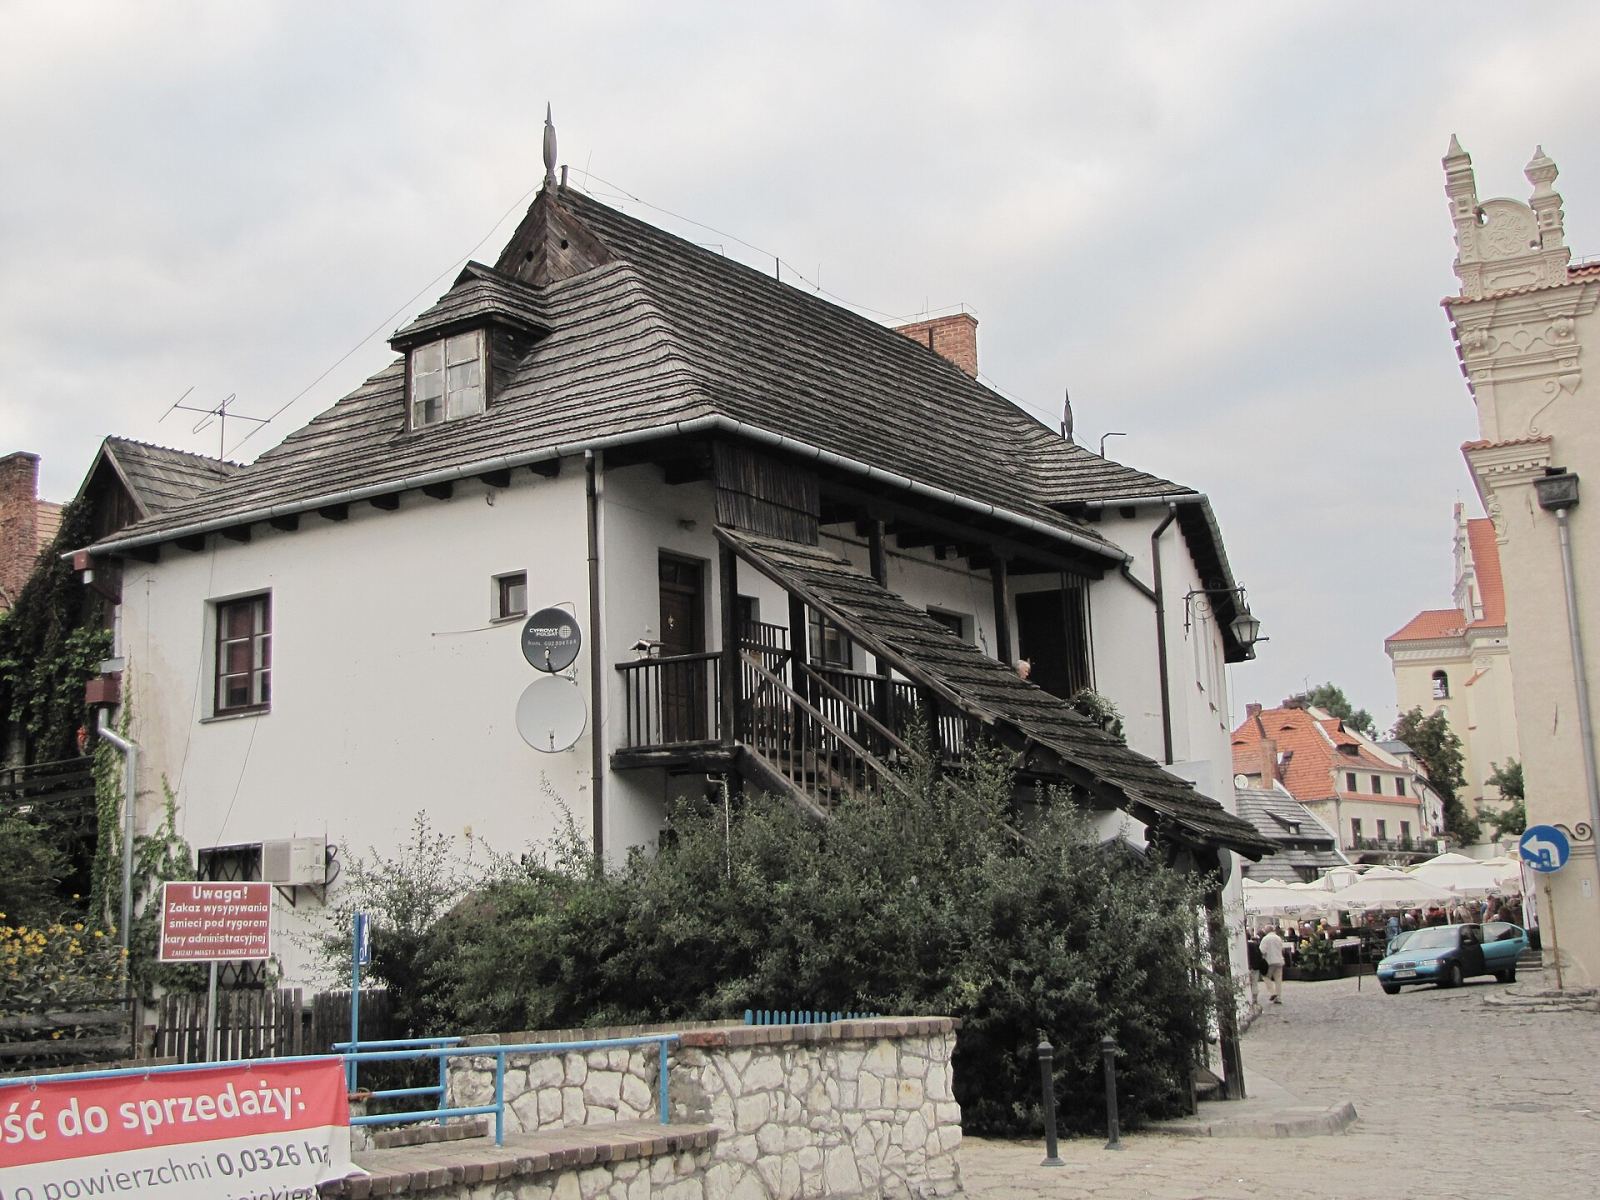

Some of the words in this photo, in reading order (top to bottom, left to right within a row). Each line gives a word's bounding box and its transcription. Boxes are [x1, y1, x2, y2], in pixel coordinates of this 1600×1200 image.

[192, 886, 248, 902] Uwaga!
[169, 903, 201, 913] Zakaz
[203, 902, 268, 915] wysypywania
[169, 918, 202, 928] śmieci
[204, 918, 224, 930] pod
[226, 919, 268, 930] rygorem
[164, 933, 186, 946] kary
[188, 932, 266, 945] administracyjnej
[0, 1099, 47, 1144] ść
[57, 1097, 109, 1138] do
[119, 1080, 306, 1135] sprzedaży:
[43, 1155, 212, 1200] powierzchni
[216, 1143, 301, 1178] 0,0326
